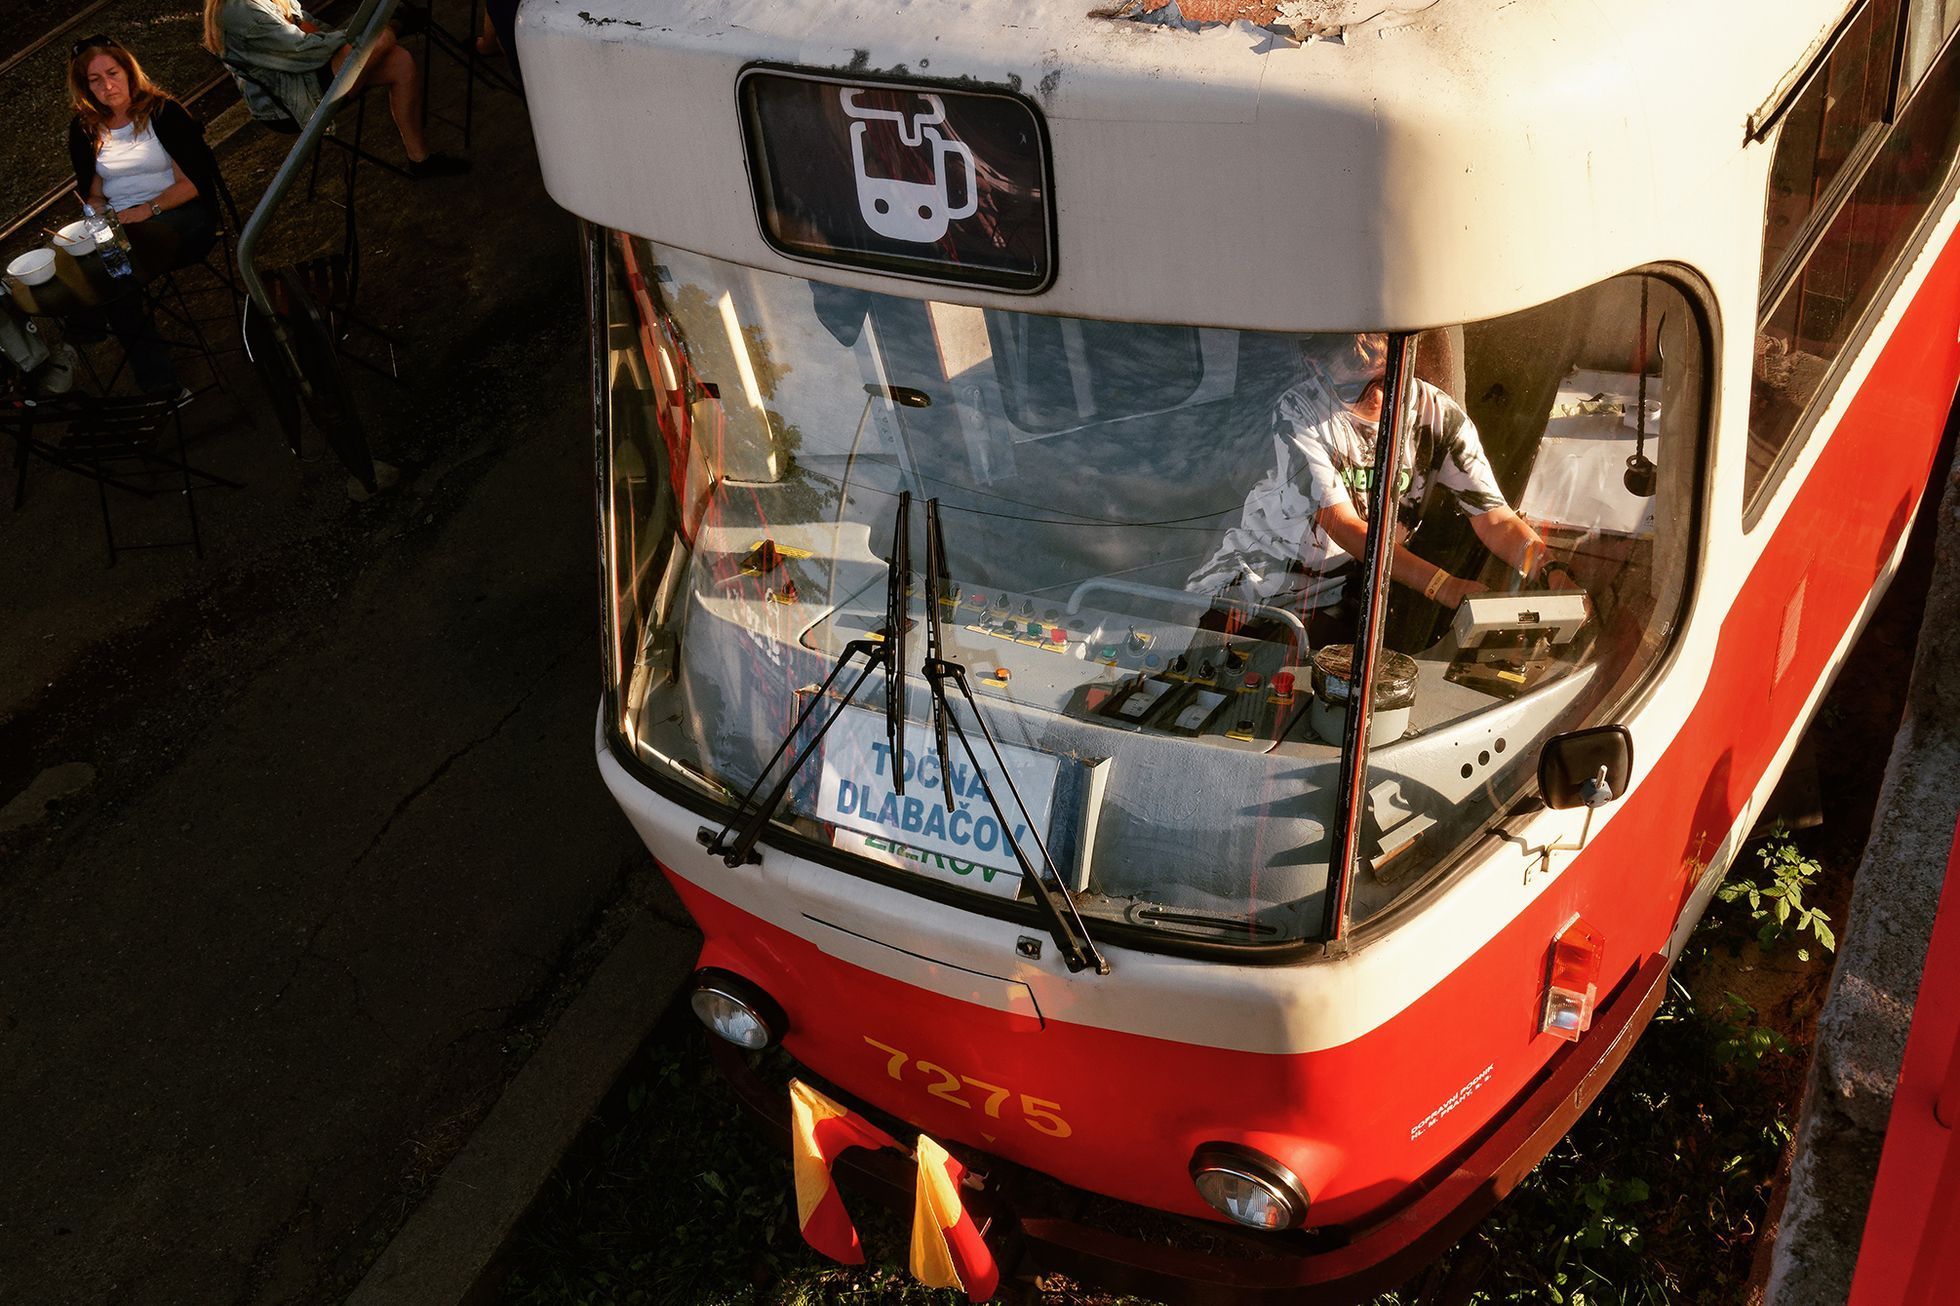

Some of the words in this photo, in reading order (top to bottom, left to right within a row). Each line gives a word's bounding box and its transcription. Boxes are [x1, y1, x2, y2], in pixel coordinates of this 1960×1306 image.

[871, 741, 991, 803] TOČNA
[836, 778, 1026, 858] DLABAČOV
[863, 1035, 1073, 1138] 7275
[1460, 1063, 1494, 1096] PODNIK
